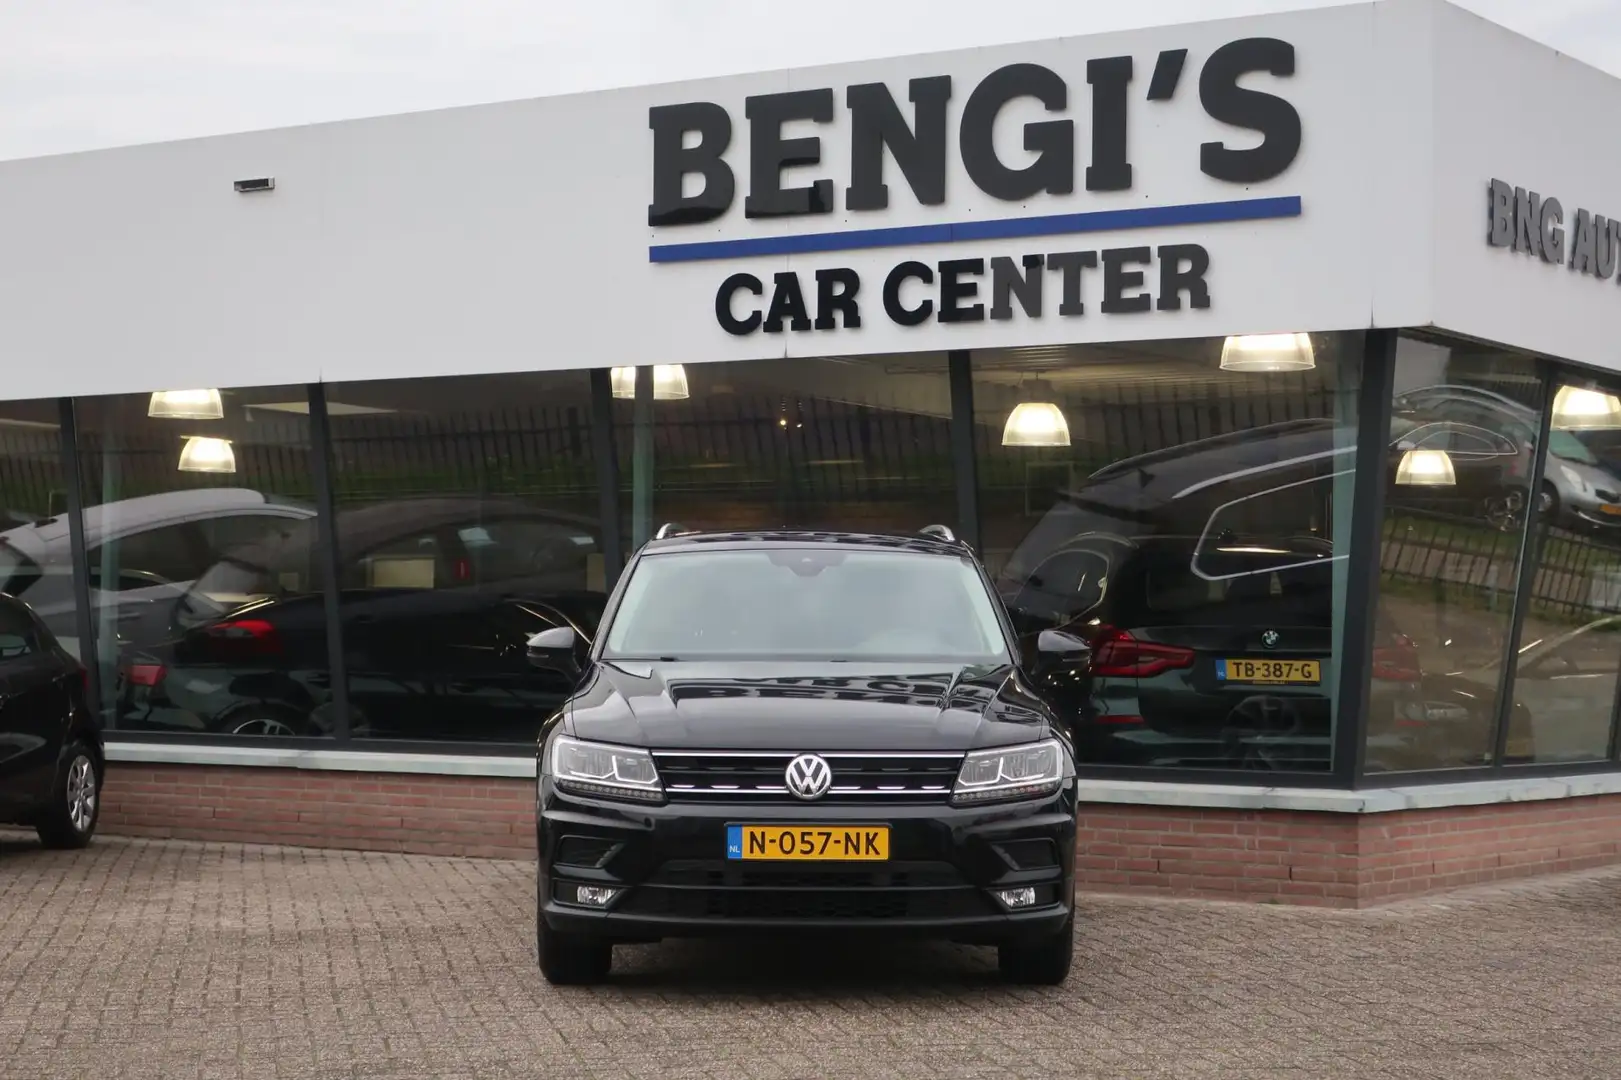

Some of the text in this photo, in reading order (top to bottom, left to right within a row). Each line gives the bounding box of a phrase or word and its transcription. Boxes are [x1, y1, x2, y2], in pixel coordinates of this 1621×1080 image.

[648, 37, 1301, 227] BENGI'S
[1488, 178, 1621, 285] BNG AU
[715, 243, 1211, 335] CAR CENTER
[1232, 662, 1312, 678] TB-387-G
[729, 845, 741, 854] NL
[749, 831, 880, 855] N-057-NK
